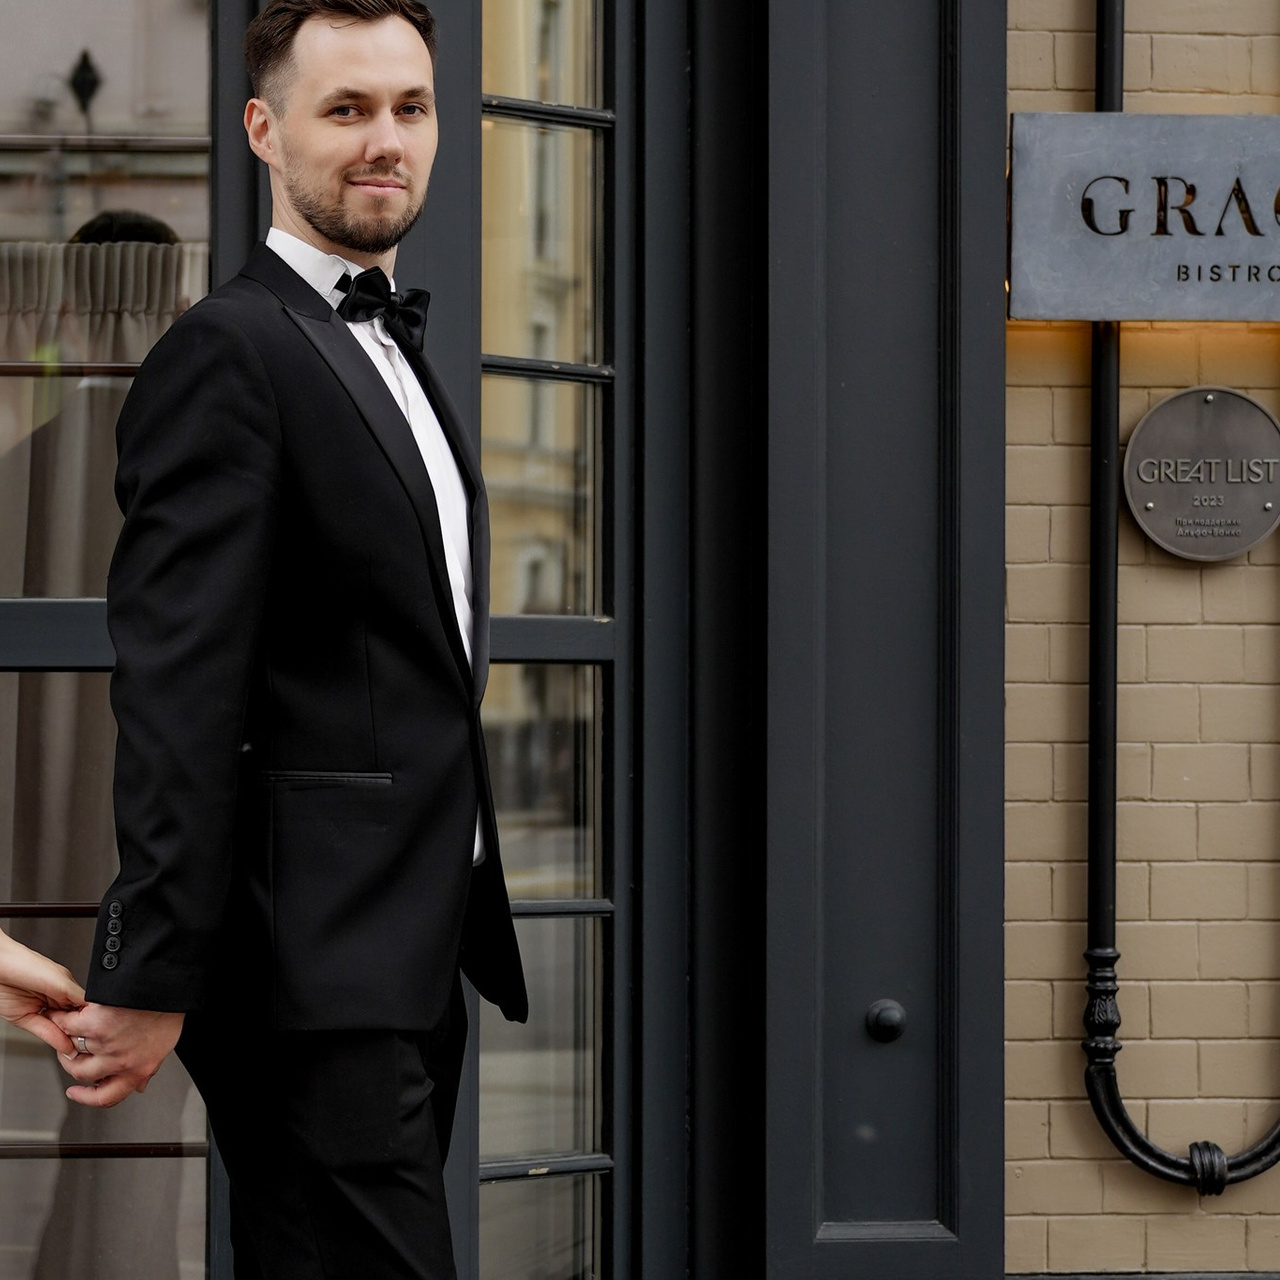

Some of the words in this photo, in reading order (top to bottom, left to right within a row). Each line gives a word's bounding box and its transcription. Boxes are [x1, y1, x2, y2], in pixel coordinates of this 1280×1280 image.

[1081, 175, 1280, 237] GRA
[1177, 265, 1280, 282] BISTRO
[1137, 458, 1221, 483] GREAT
[1226, 458, 1280, 483] LIST
[1193, 495, 1224, 507] 2023
